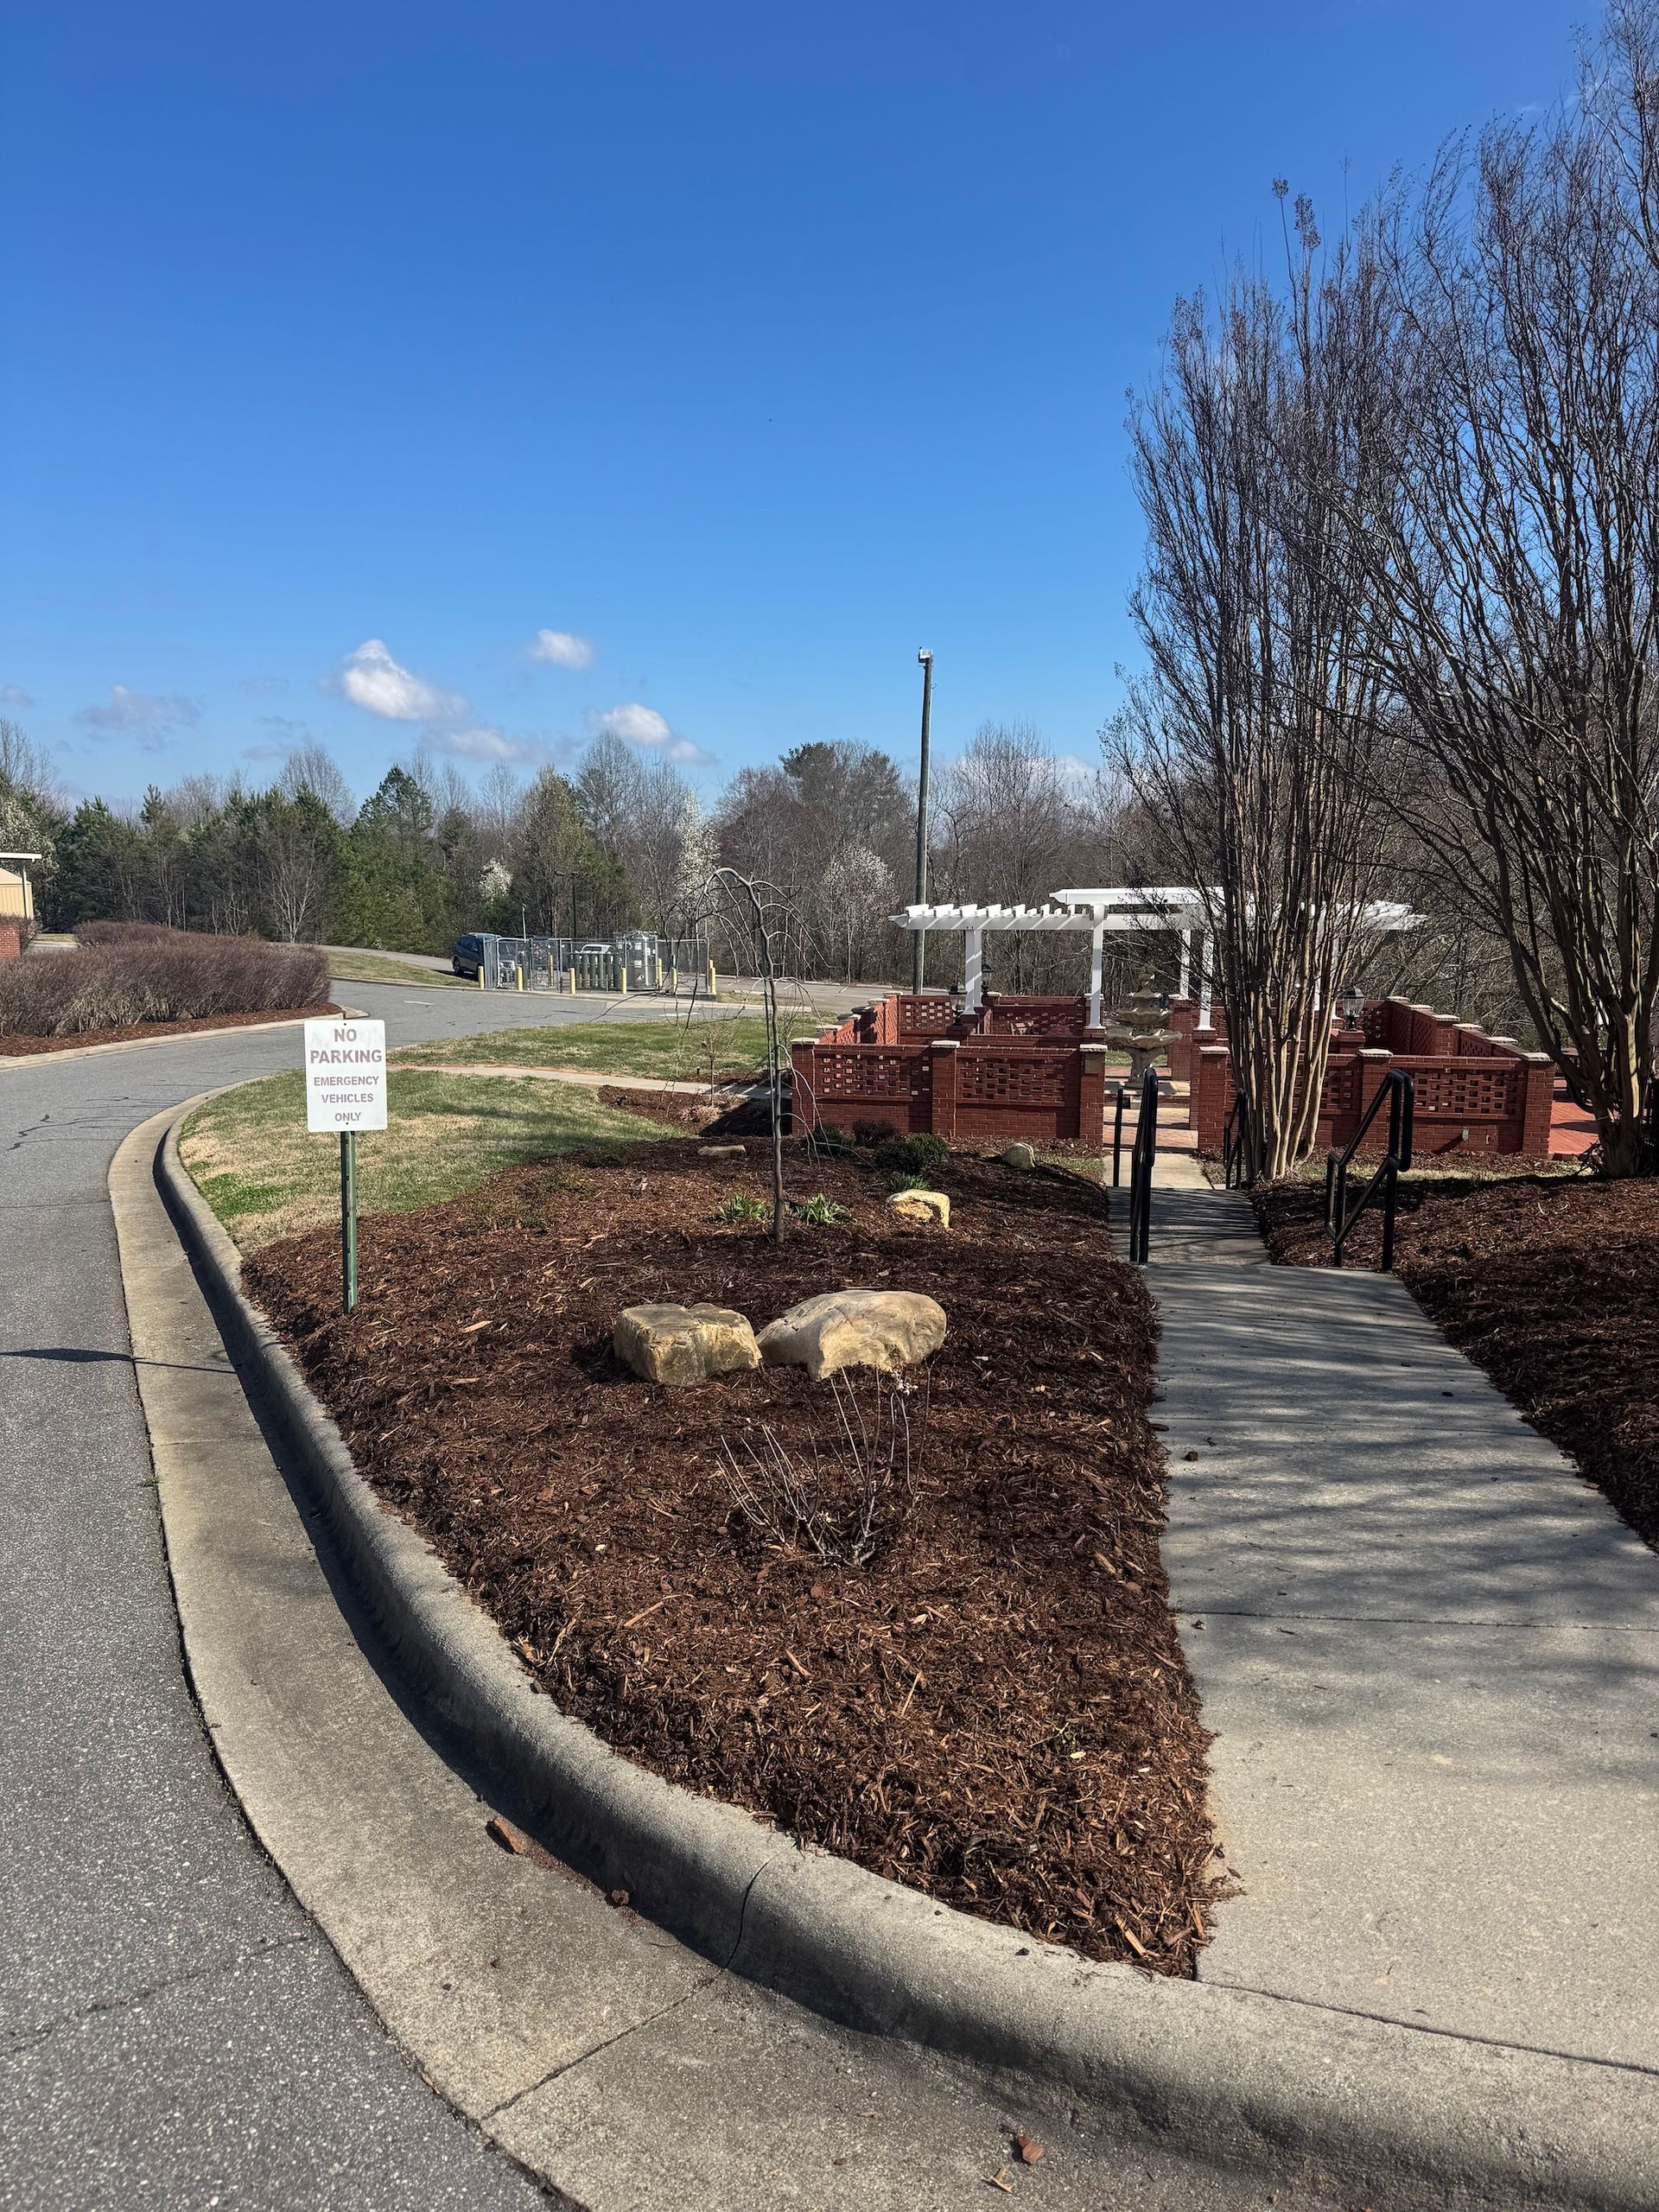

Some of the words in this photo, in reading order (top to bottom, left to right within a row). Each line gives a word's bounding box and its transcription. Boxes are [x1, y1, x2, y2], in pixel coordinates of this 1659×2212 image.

[334, 1028, 357, 1042] NO
[310, 1050, 382, 1064] PARKING
[313, 1076, 379, 1086] EMERGENCY
[321, 1093, 373, 1103] VEHICLES
[334, 1112, 361, 1122] ONLY
